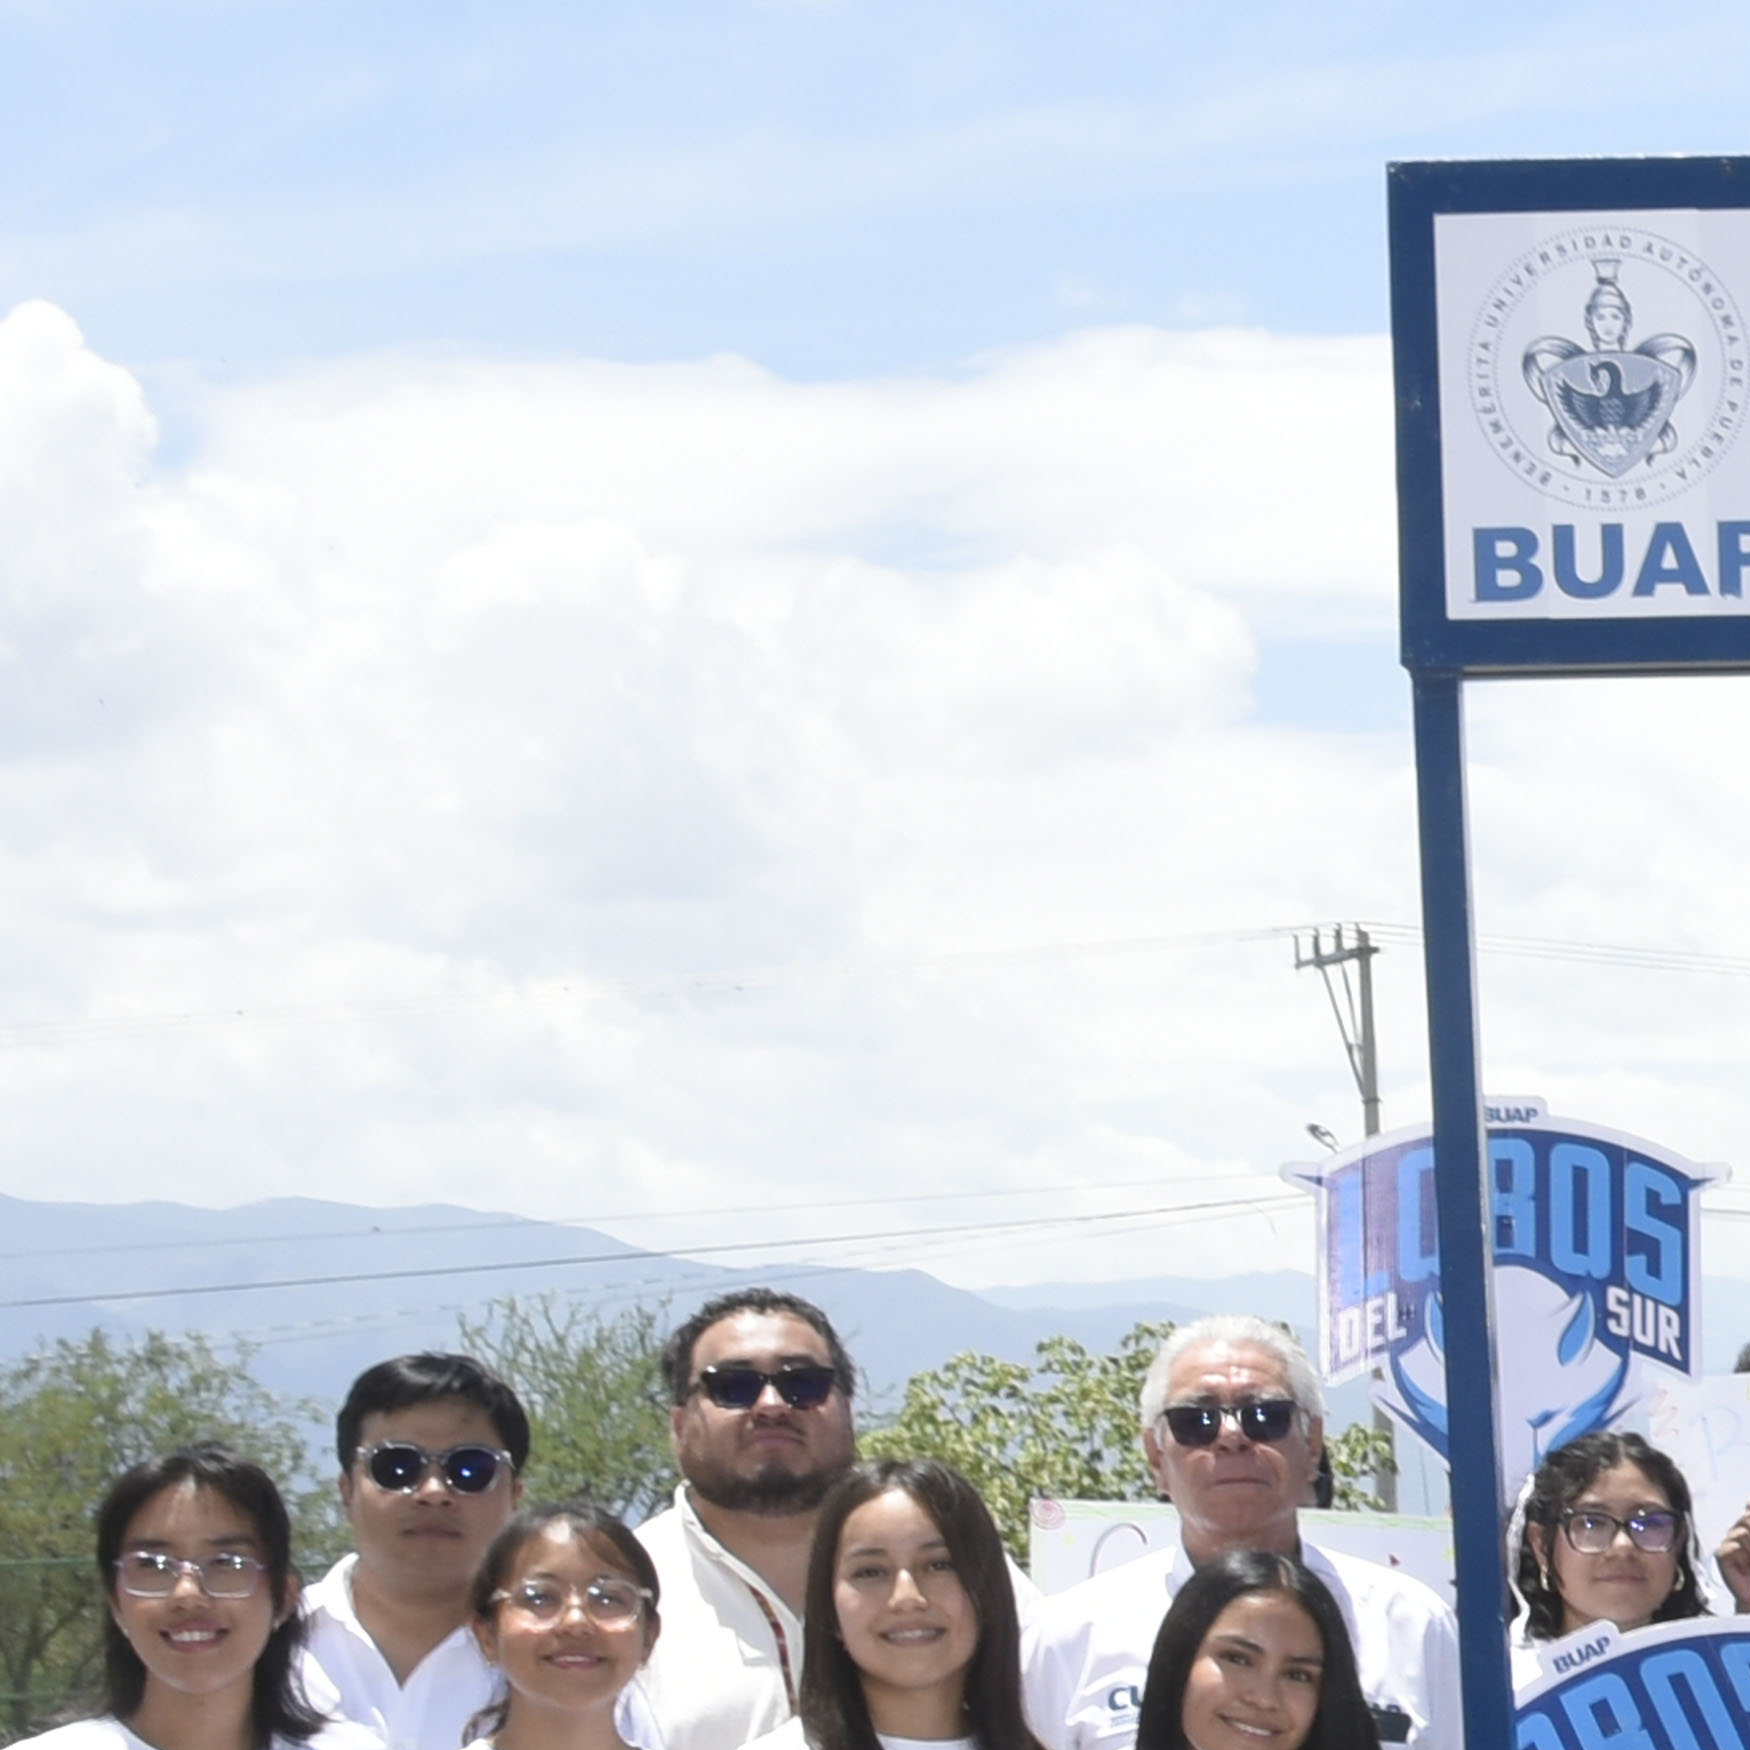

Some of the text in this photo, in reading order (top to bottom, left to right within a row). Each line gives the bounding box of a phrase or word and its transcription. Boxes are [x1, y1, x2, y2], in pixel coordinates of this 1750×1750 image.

[1486, 234, 1632, 328] UNIVERSIDAD
[1337, 1292, 1408, 1359] DEL
[1606, 1286, 1683, 1362] SUR
[1553, 1636, 1611, 1674] BUAP
